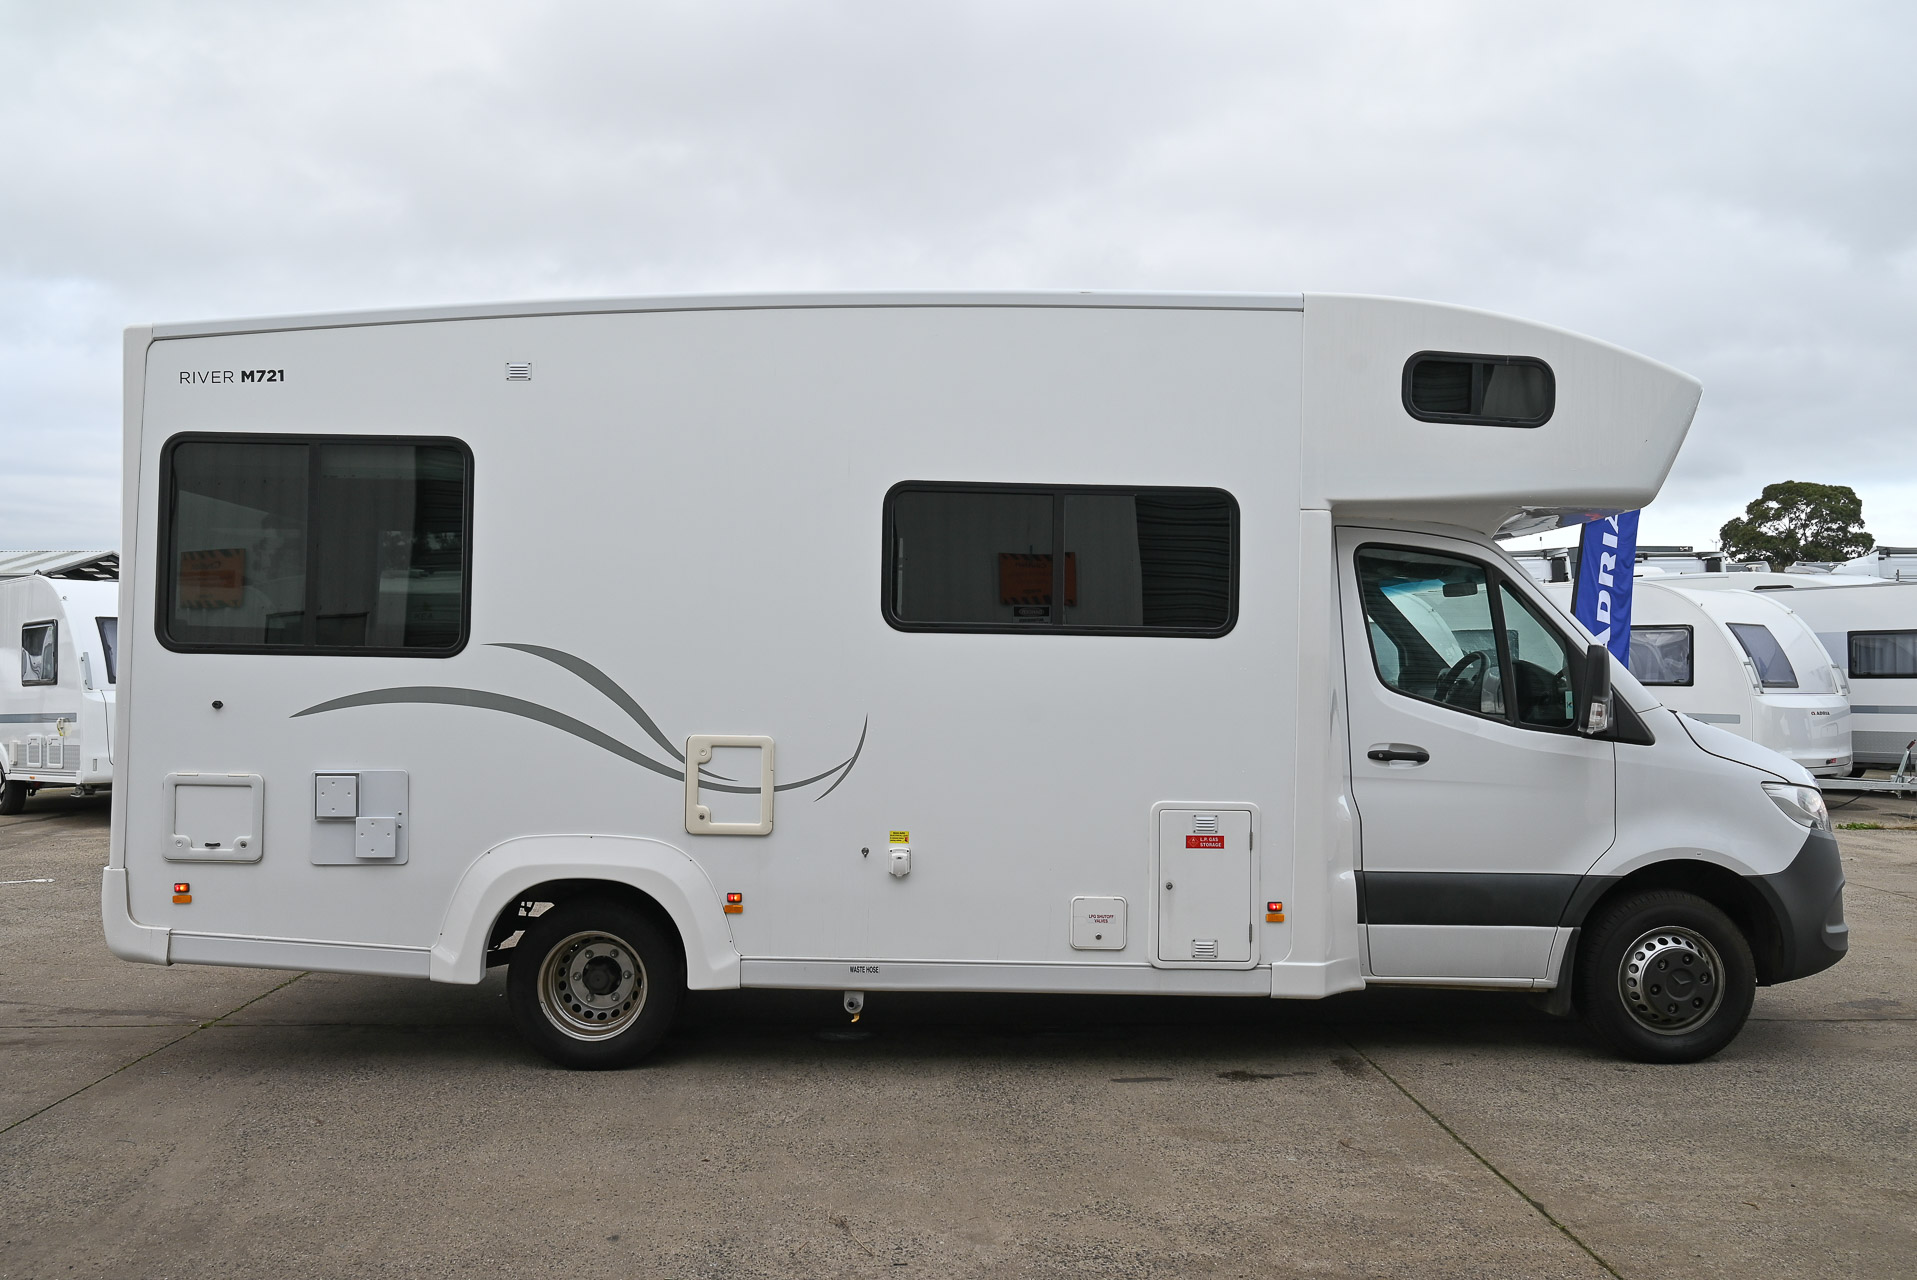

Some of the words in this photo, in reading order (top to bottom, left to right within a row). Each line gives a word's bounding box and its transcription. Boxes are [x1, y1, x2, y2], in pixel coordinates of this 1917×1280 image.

[179, 370, 234, 384] RIVER
[241, 369, 284, 383] M721
[849, 965, 866, 973] WASTE
[866, 965, 879, 974] HOSE
